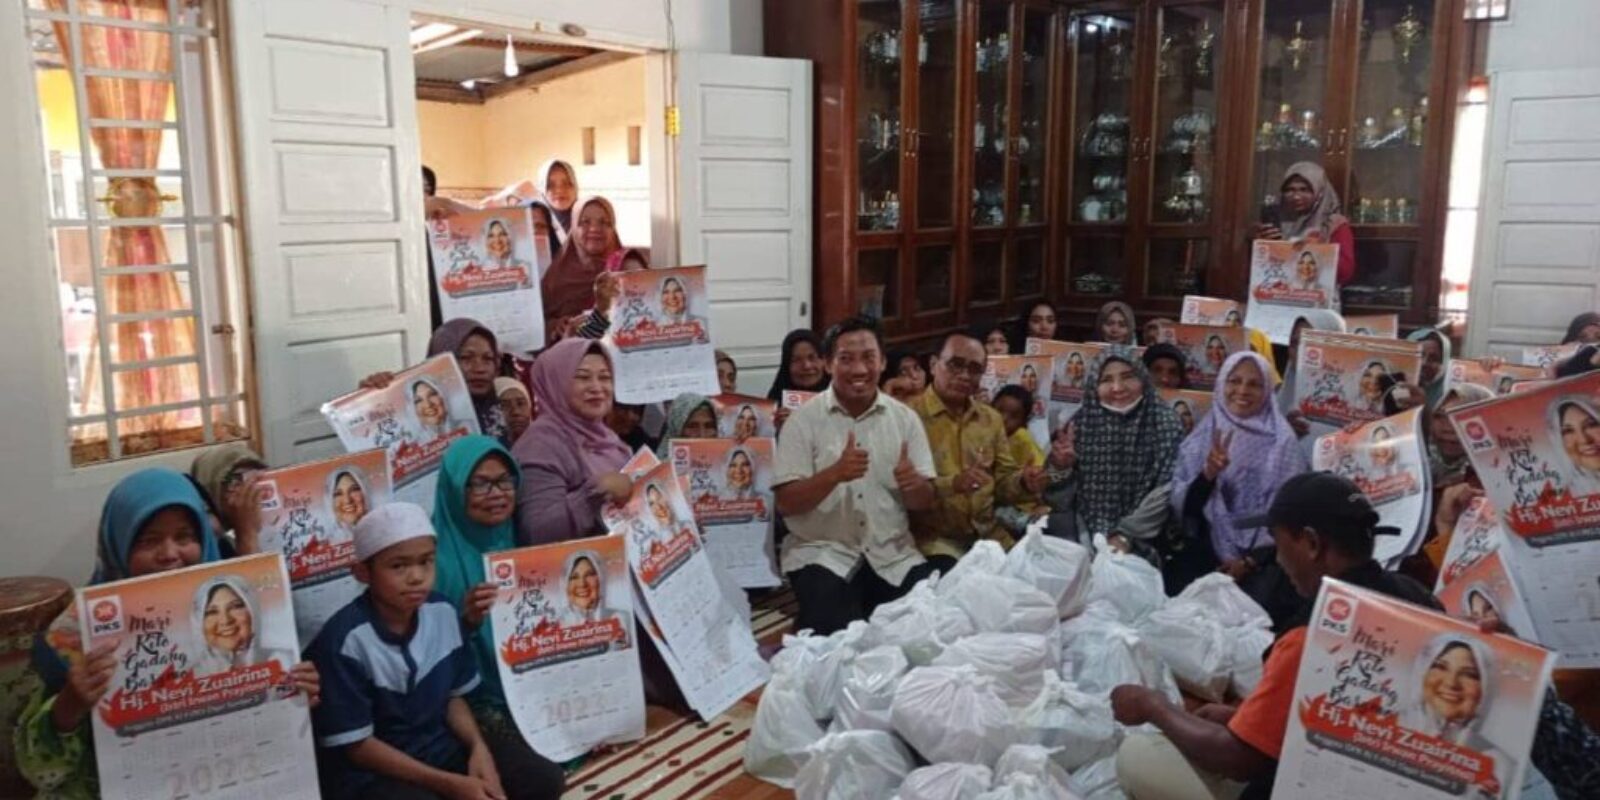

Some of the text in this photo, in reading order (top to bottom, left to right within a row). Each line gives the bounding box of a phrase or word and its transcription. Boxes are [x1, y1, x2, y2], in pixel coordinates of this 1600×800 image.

[94, 621, 121, 633] PKS
[1322, 619, 1347, 633] PKS
[120, 691, 149, 711] Hj.
[151, 684, 193, 703] Nevi
[199, 664, 271, 693] Zuairina
[1318, 702, 1348, 726] Hj.
[1349, 712, 1393, 740] Nevi
[1399, 727, 1480, 772] Zuairina
